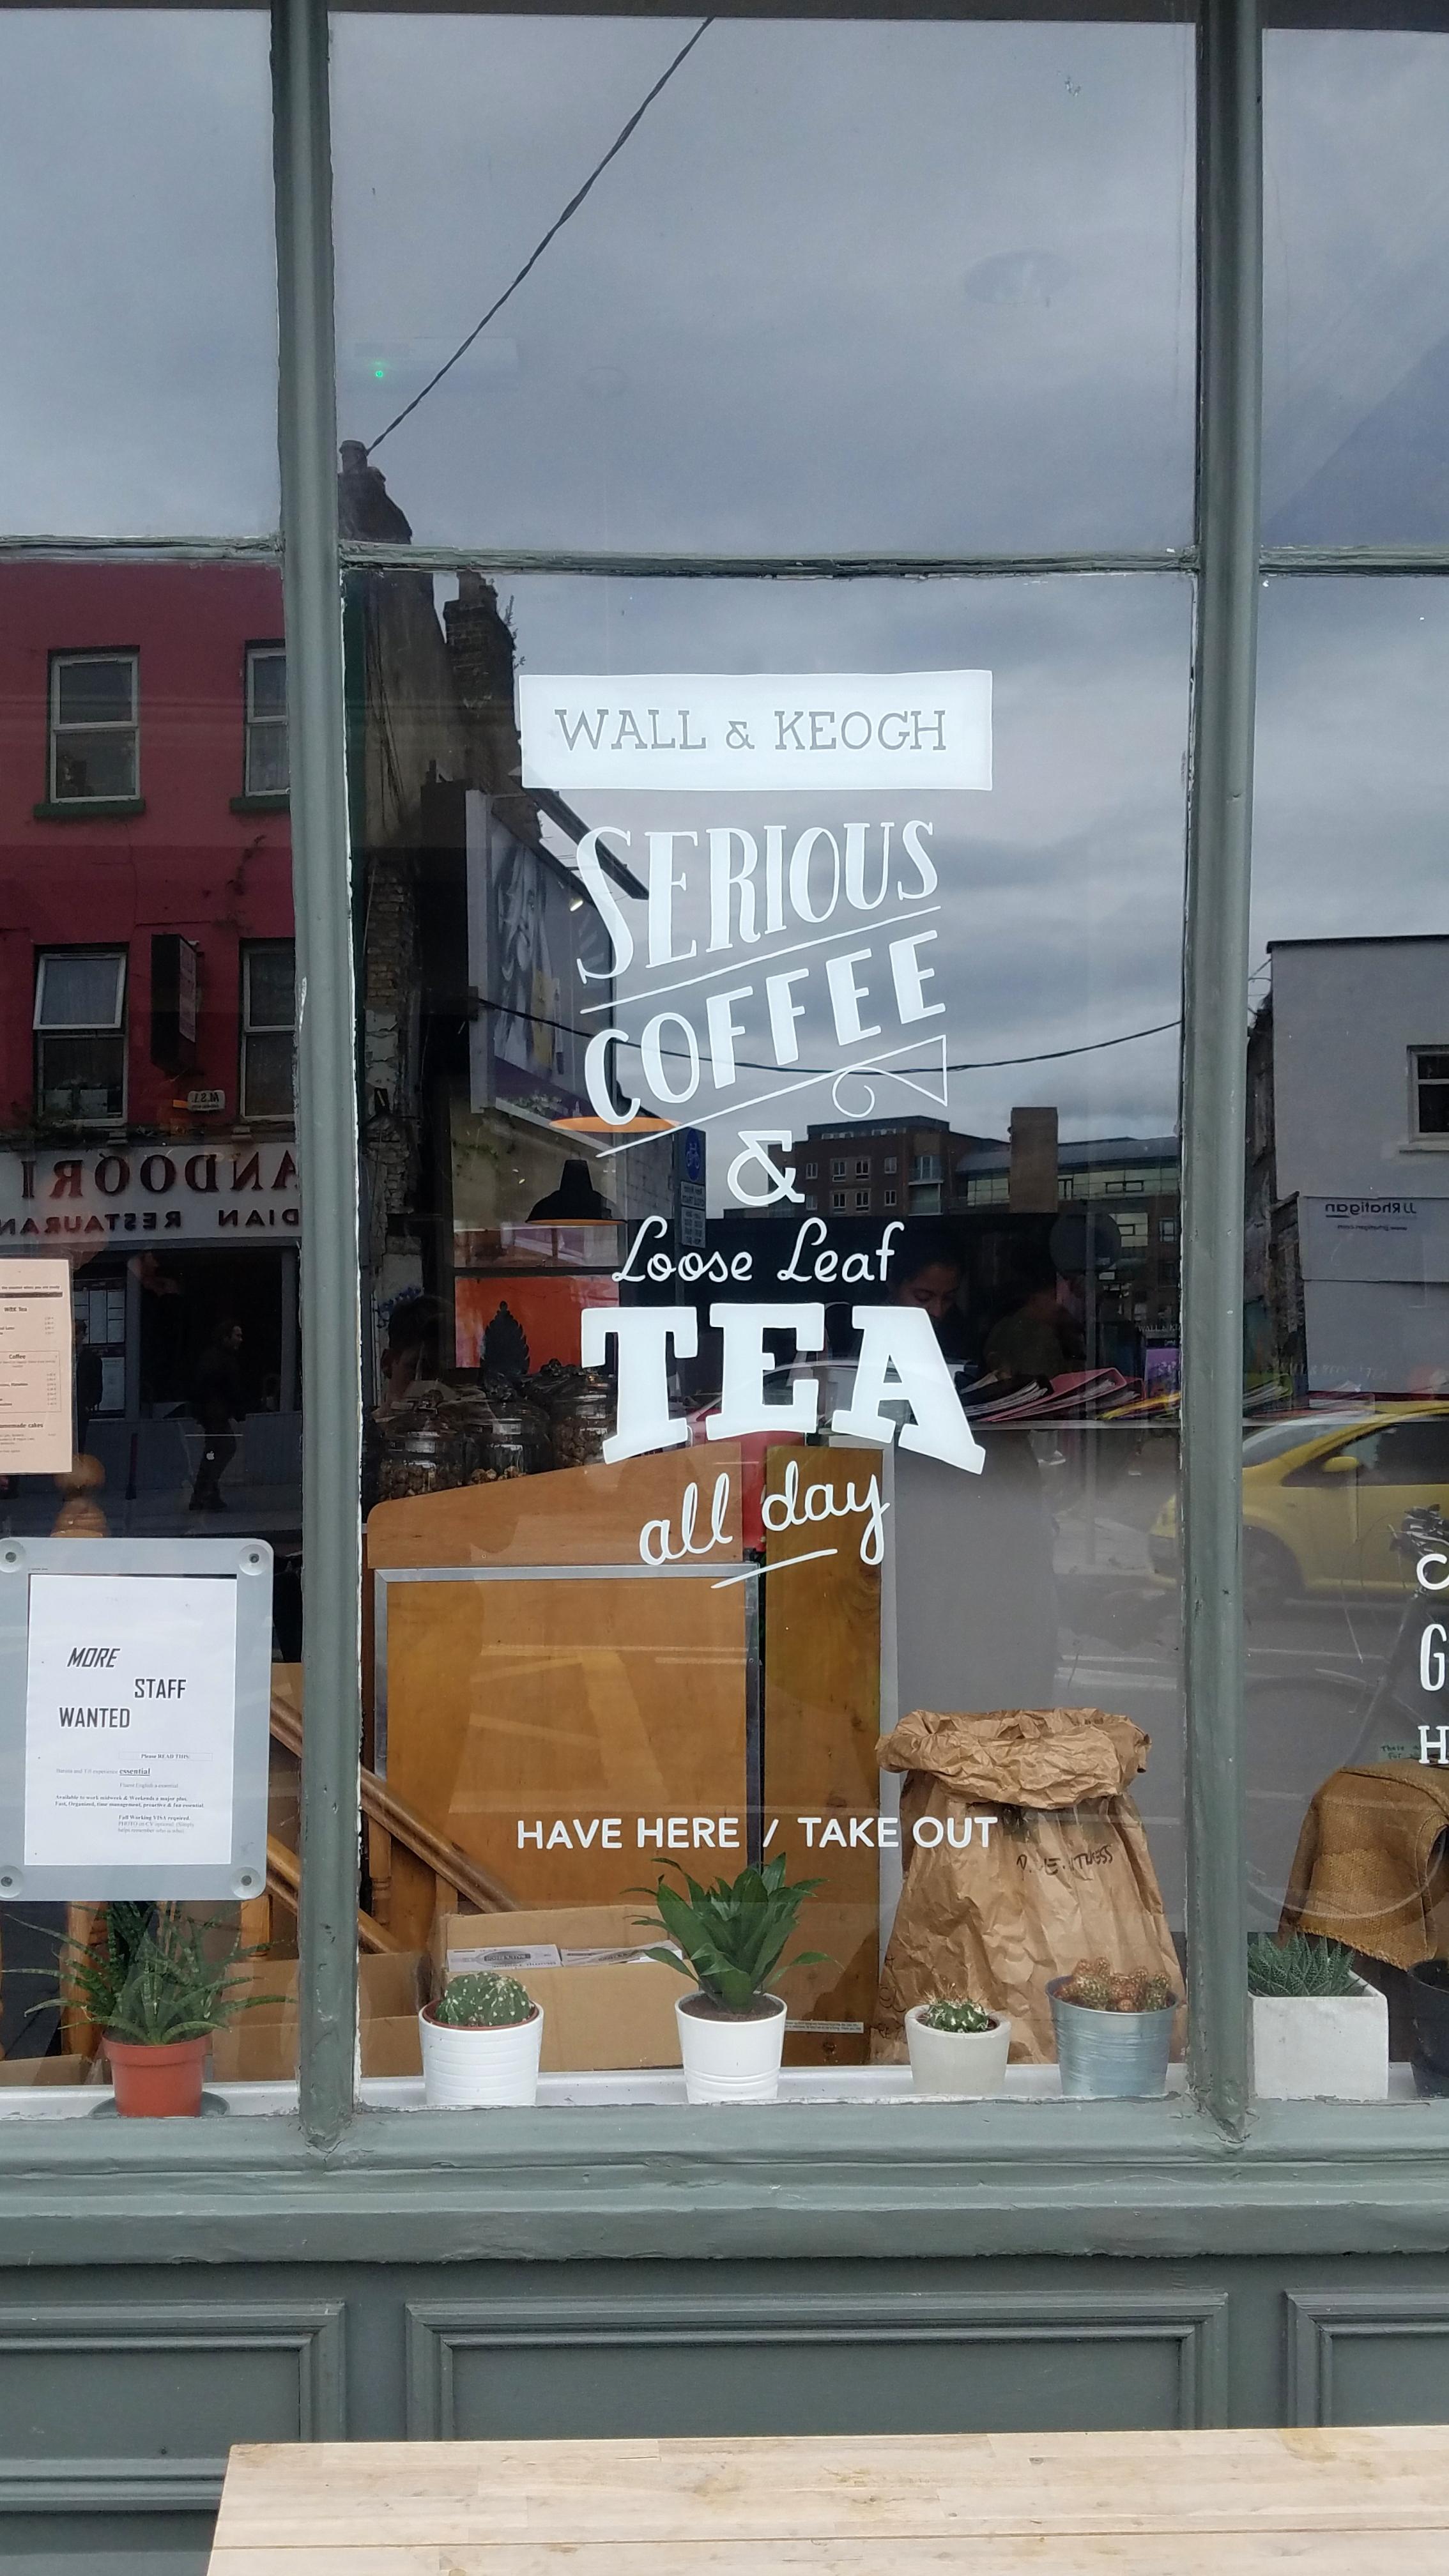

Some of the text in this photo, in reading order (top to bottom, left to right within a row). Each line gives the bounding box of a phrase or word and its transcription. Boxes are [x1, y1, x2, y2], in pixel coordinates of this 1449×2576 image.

[554, 708, 947, 752] WALL & KEOGH
[575, 819, 939, 985] SERIOUS
[583, 930, 947, 1126] COFFEE
[726, 1130, 805, 1207] &
[611, 1215, 753, 1283] Loose
[777, 1216, 905, 1283] Leaf
[581, 1302, 986, 1475] TEA
[639, 1460, 891, 1566] all day
[67, 1647, 120, 1668] MORE
[134, 1678, 187, 1699] STAFF
[59, 1707, 131, 1729] WANTED
[517, 1816, 998, 1850] HAVE HERE / TAKE OUT
